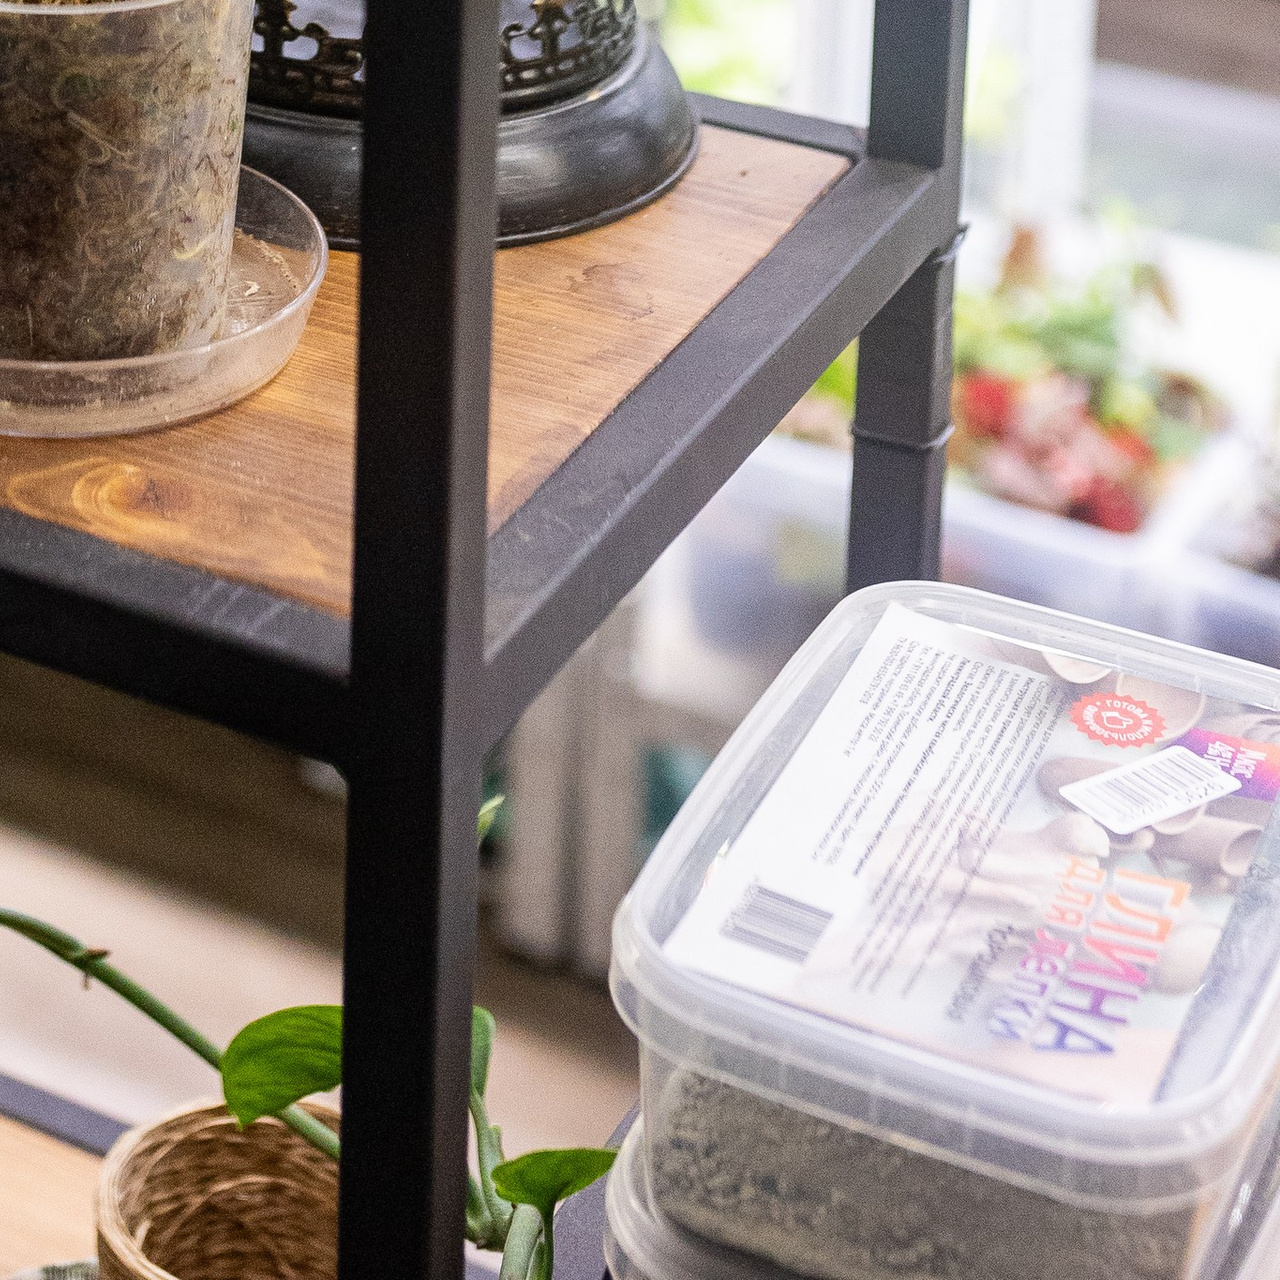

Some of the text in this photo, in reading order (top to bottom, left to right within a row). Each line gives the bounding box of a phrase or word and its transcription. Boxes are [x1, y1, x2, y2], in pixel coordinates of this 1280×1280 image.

[1008, 676, 1037, 711] Инструкция
[1105, 699, 1148, 721] ГОТОВА
[1044, 854, 1108, 929] ДЛЯ
[1032, 867, 1192, 1054] ГЛИНА
